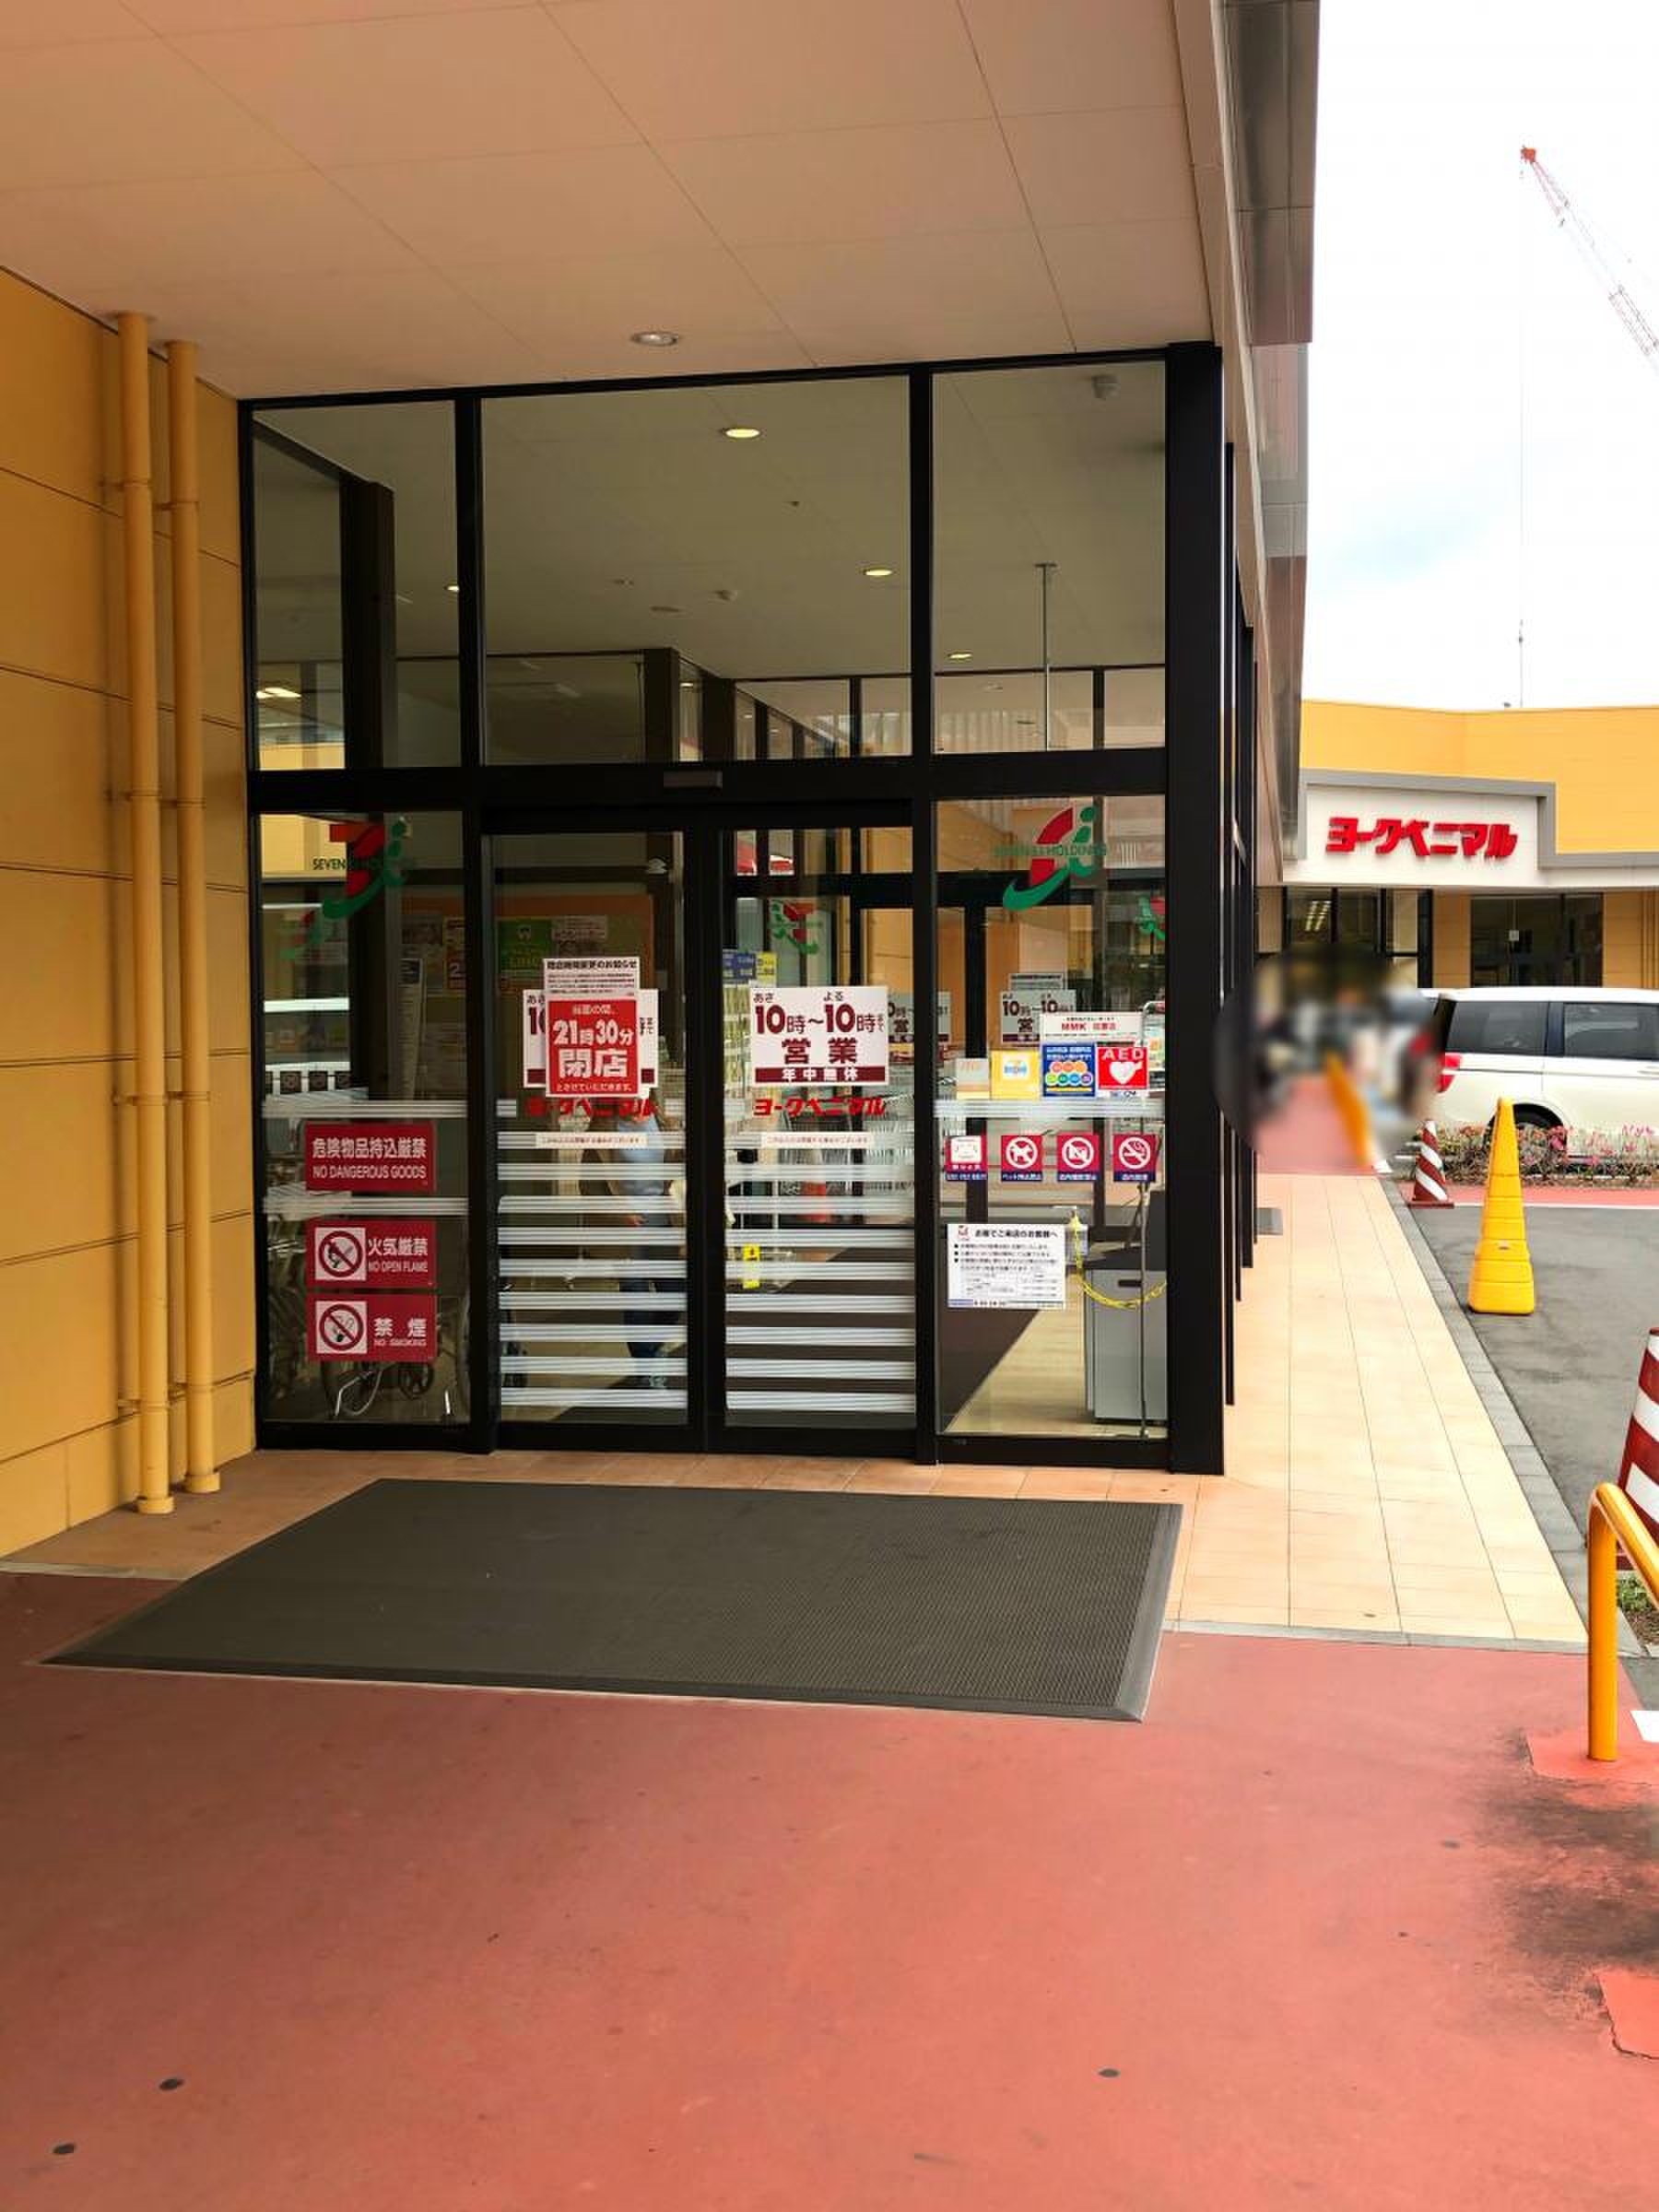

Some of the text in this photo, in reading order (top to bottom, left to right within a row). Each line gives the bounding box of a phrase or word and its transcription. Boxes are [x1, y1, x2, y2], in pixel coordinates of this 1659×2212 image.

[1325, 817, 1519, 859] ヨークベニマル
[553, 1019, 634, 1045] 21時30分
[782, 1037, 858, 1065] 営業
[1101, 1049, 1145, 1060] AED
[559, 1048, 629, 1078] 閉店
[753, 1096, 887, 1118] ヨークベニマル
[312, 1137, 427, 1159] 危険物品持込厳禁
[312, 1165, 427, 1179] NO DANGEROUS GOODS
[368, 1238, 429, 1256] 火気厳禁
